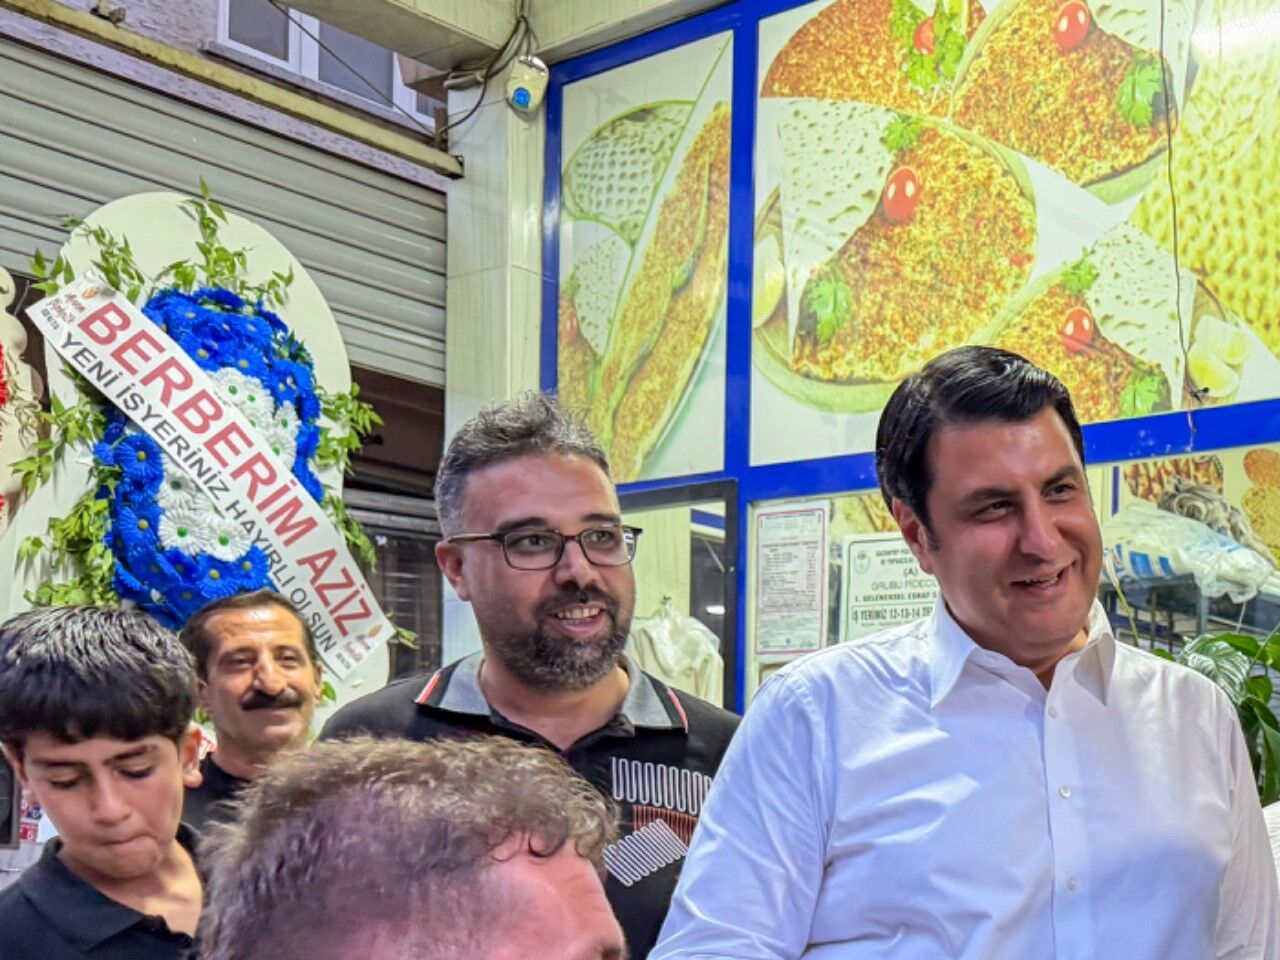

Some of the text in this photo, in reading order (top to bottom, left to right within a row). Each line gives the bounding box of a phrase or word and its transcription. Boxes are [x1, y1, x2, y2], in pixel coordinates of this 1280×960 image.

[61, 331, 123, 388] YENİ
[225, 500, 295, 587] HAYIRLI
[77, 301, 372, 637] BERBERİM AZİZ
